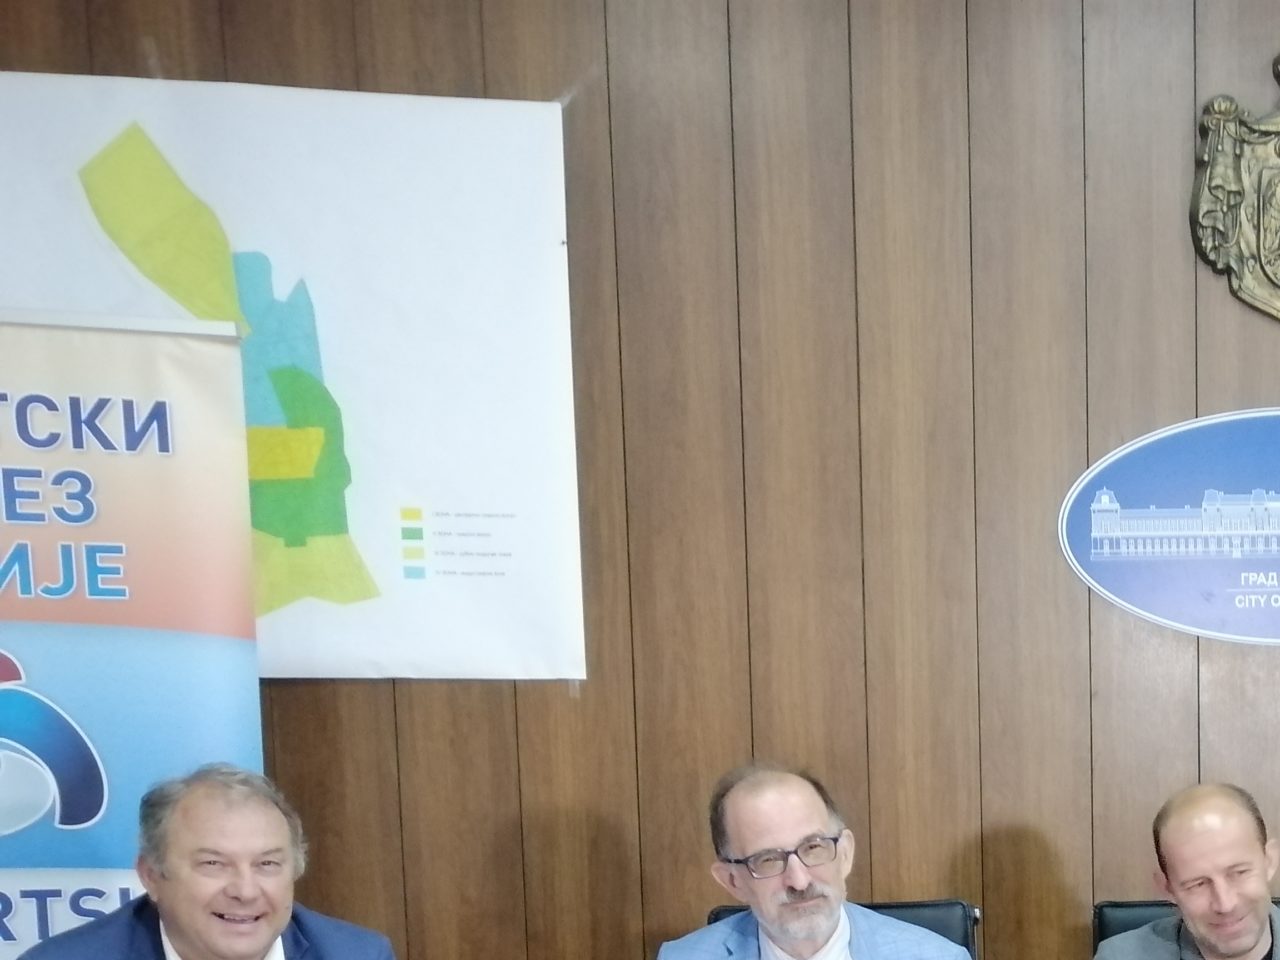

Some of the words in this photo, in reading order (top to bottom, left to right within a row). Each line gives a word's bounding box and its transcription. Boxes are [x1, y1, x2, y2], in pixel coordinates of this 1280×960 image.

[0, 393, 171, 454] СКИ
[1241, 572, 1278, 587] ГРАД
[1235, 594, 1268, 608] CITY
